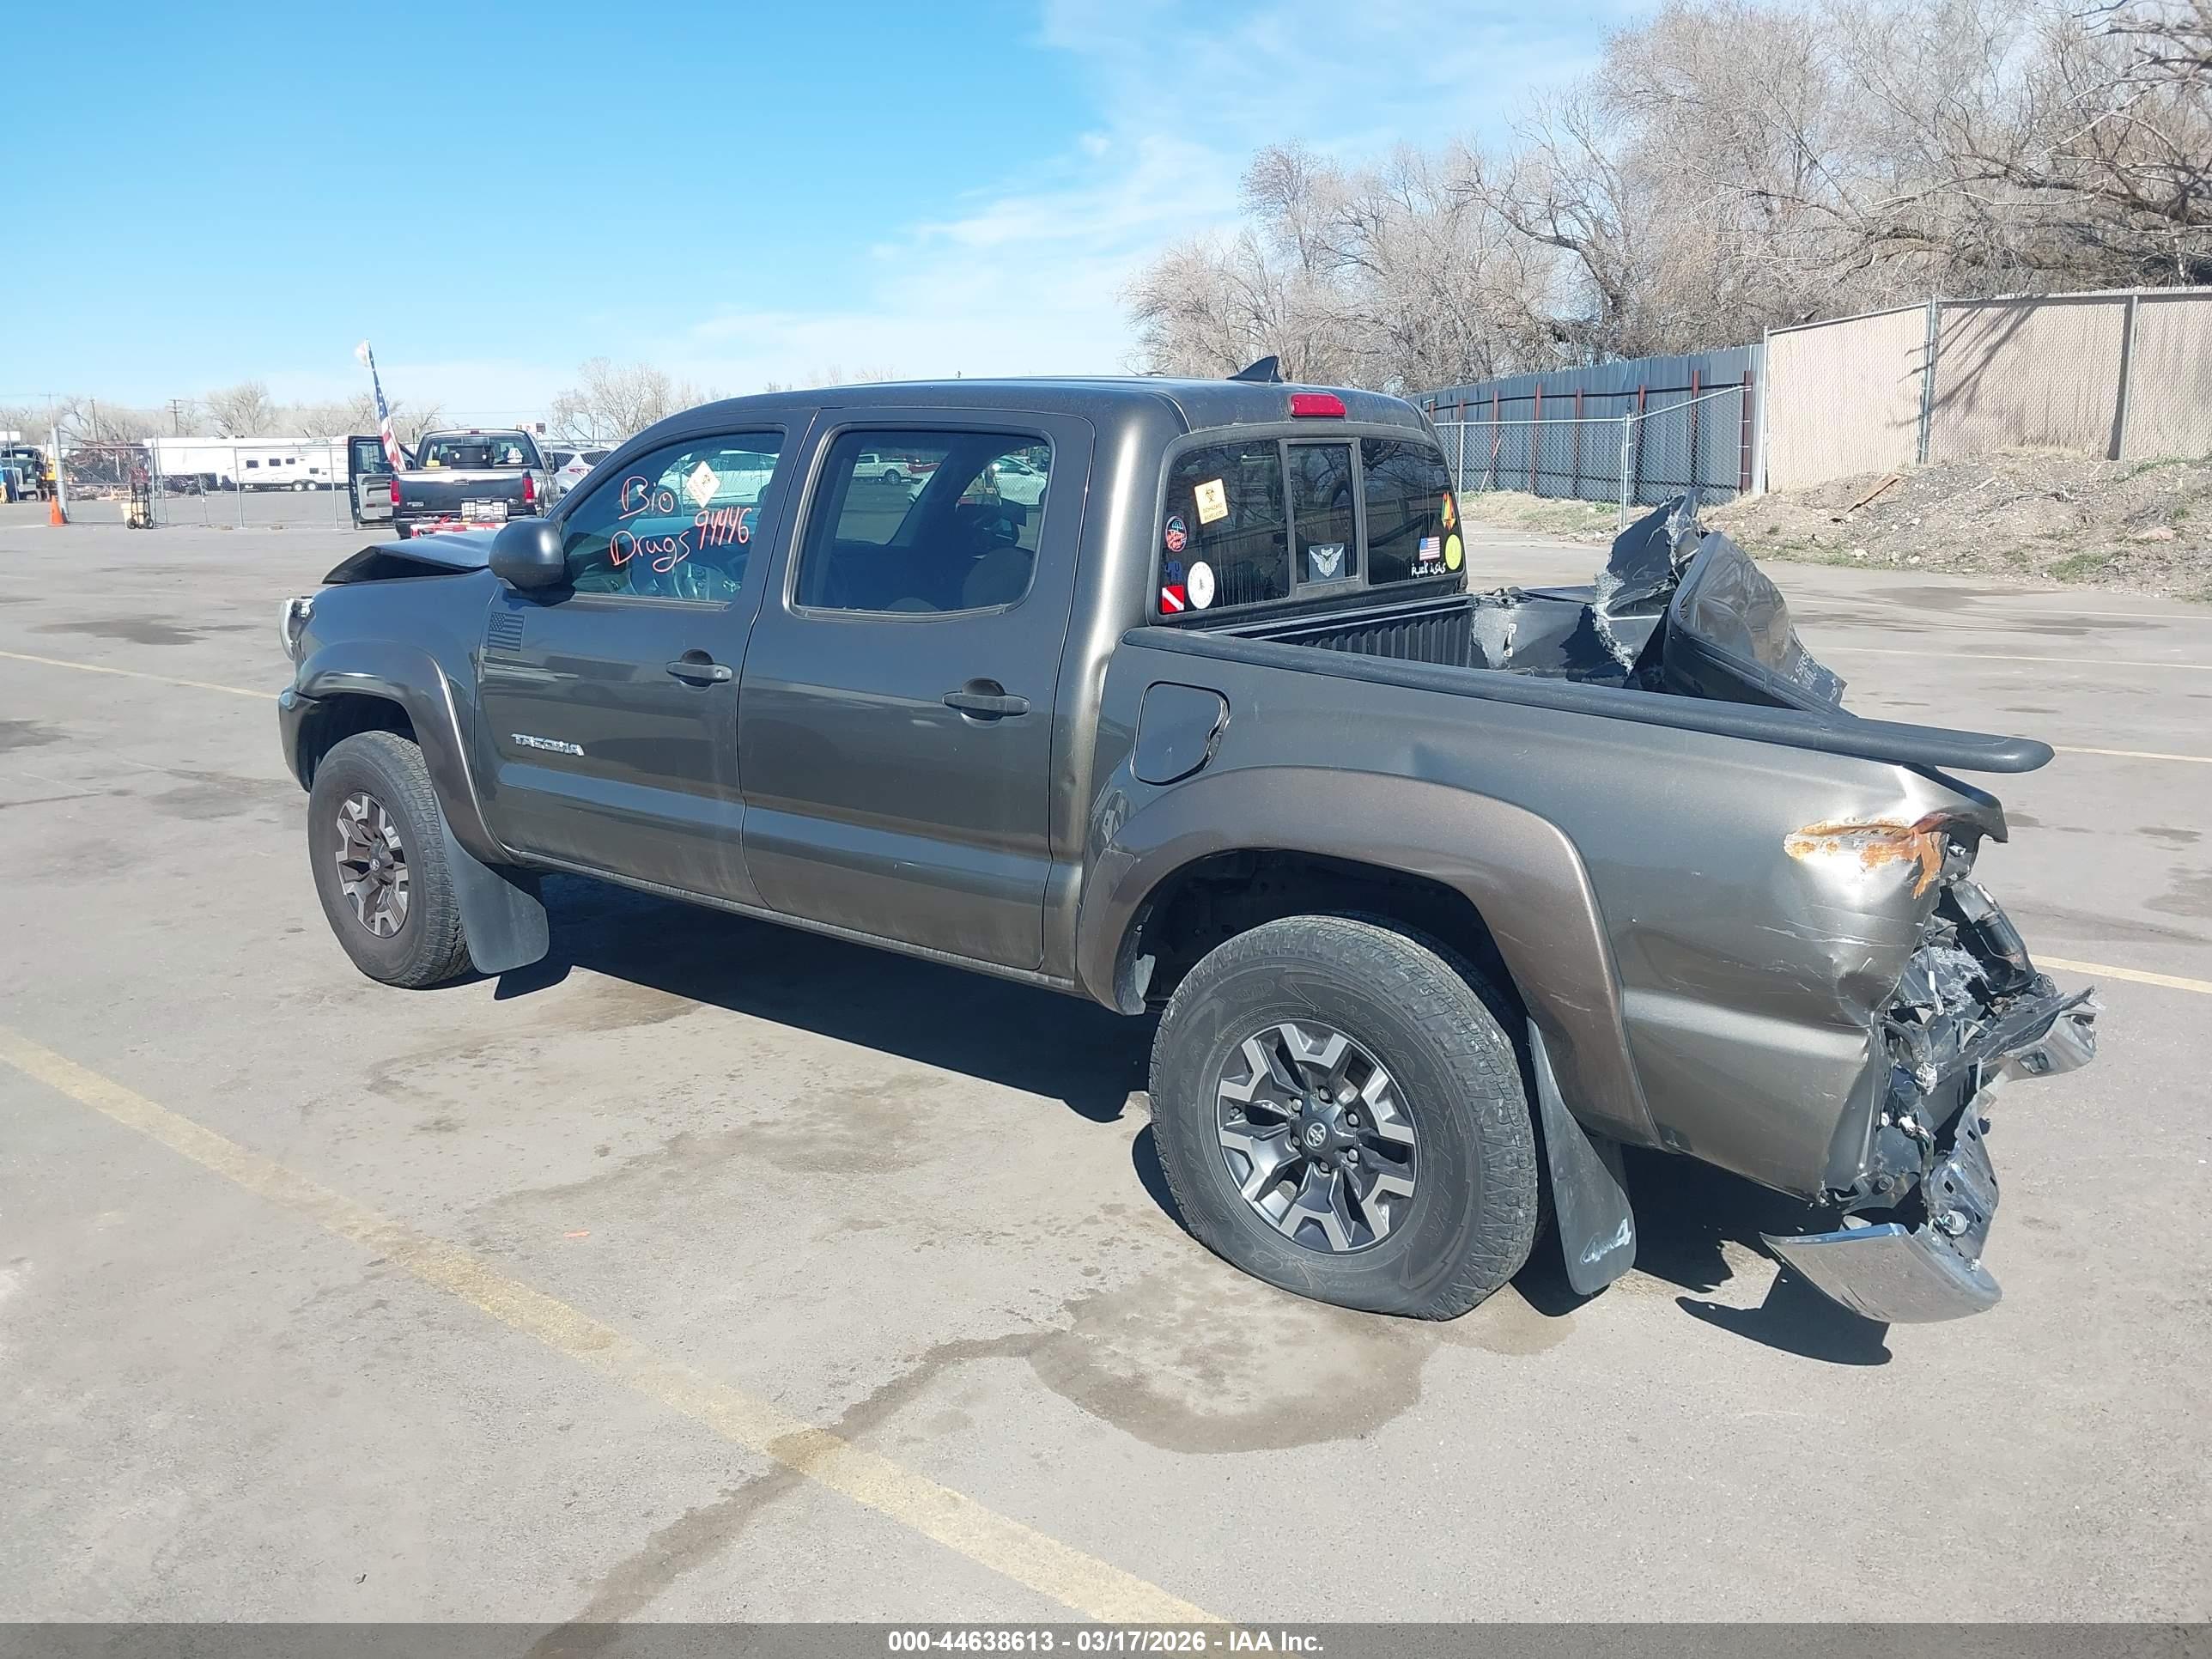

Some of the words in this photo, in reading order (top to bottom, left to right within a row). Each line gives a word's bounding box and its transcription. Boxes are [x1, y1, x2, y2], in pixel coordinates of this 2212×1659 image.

[619, 476, 674, 520] Bio
[695, 506, 752, 550] 94446
[611, 530, 690, 573] Drugs
[510, 733, 585, 757] TACOMA
